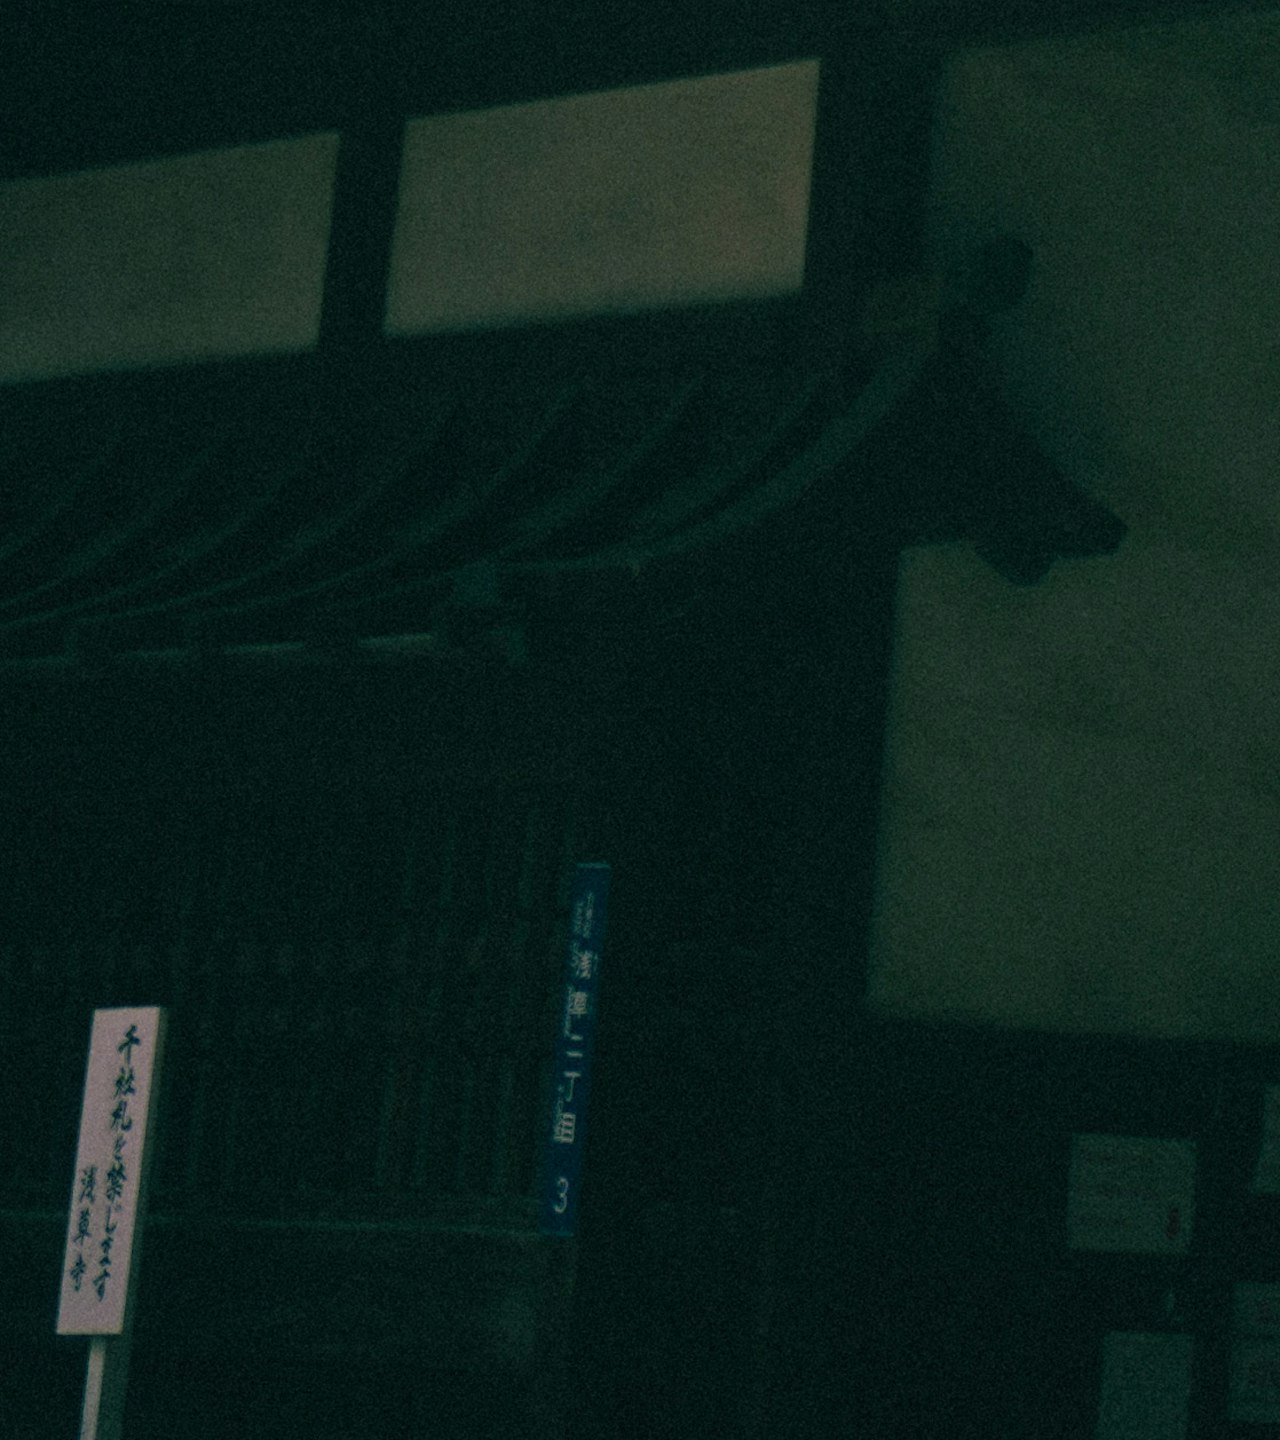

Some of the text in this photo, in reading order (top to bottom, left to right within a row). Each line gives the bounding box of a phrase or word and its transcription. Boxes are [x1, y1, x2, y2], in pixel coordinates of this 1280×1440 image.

[69, 1162, 98, 1291] 浅草寺
[554, 1177, 569, 1214] 3
